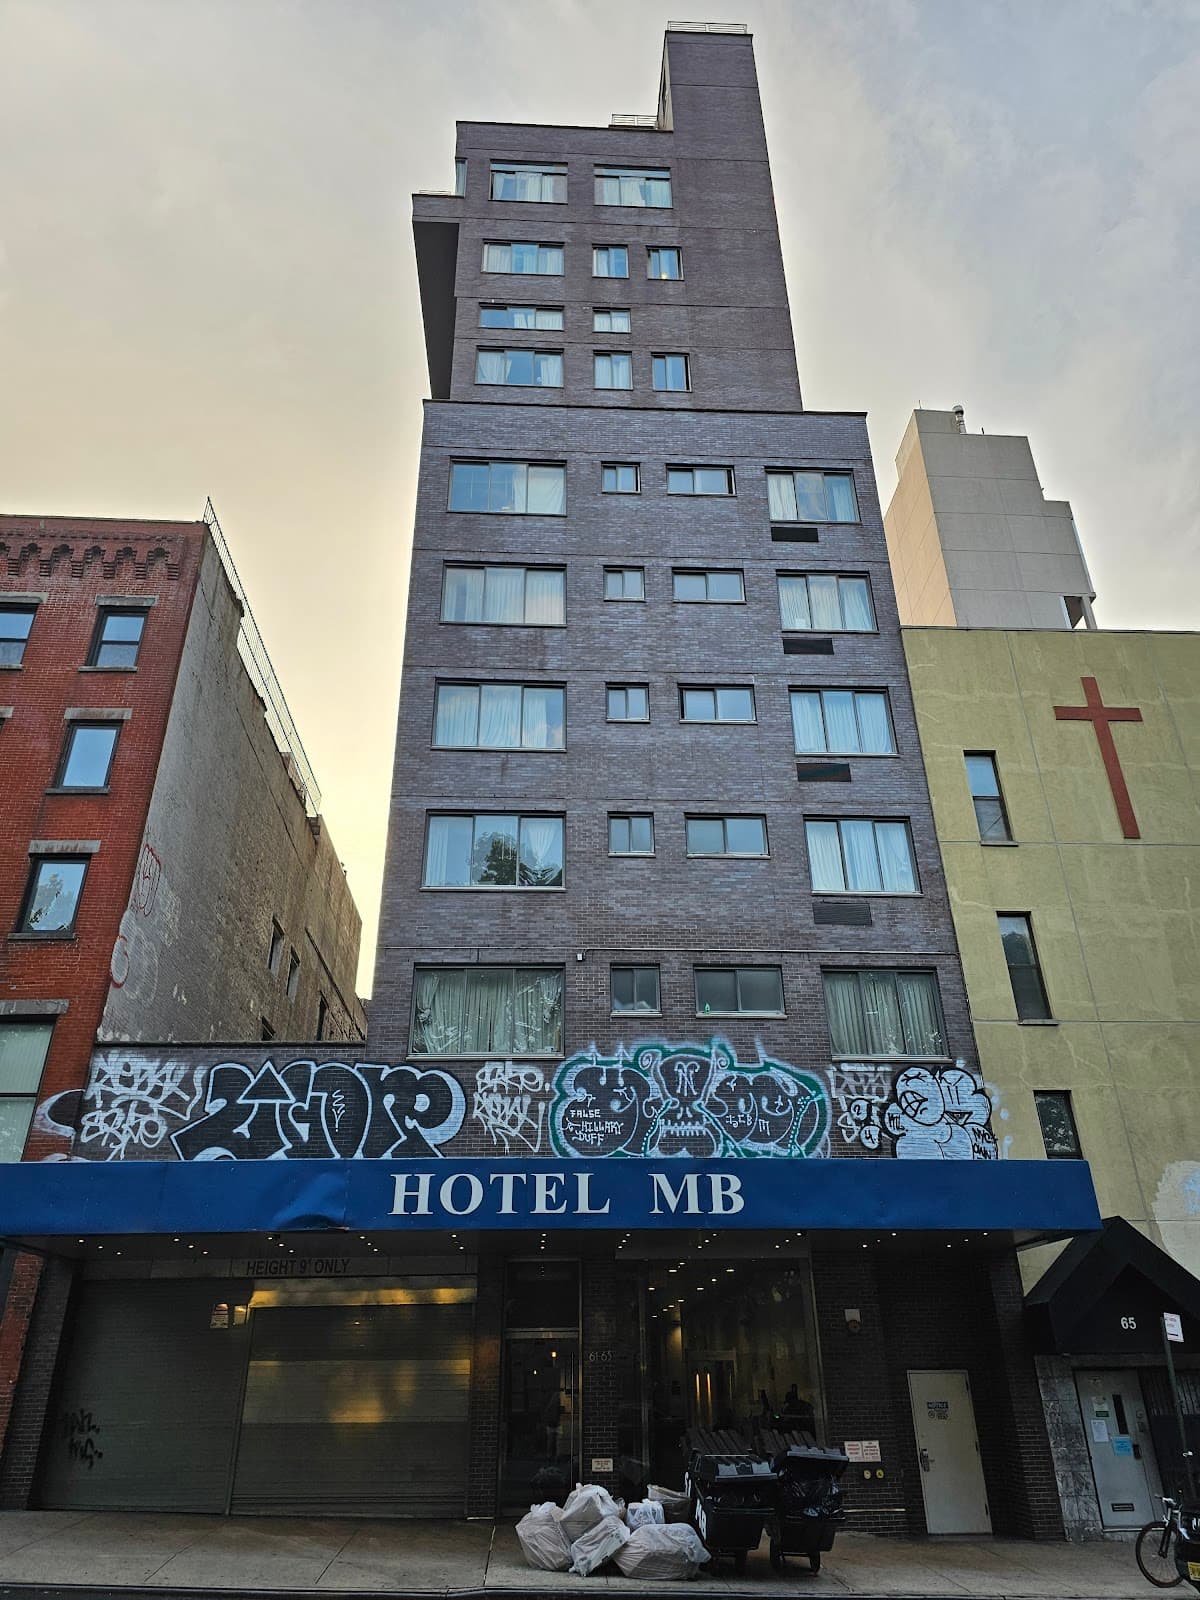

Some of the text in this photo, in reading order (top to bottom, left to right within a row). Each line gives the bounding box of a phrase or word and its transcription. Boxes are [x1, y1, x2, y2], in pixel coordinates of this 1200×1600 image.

[569, 1108, 601, 1118] FALSE
[581, 1120, 625, 1136] HILLARY
[572, 1130, 605, 1146] DUFF
[387, 1173, 745, 1215] HOTEL MB
[246, 1259, 296, 1275] HEIGHT
[314, 1258, 352, 1274] ONLY
[1120, 1316, 1137, 1330] 65
